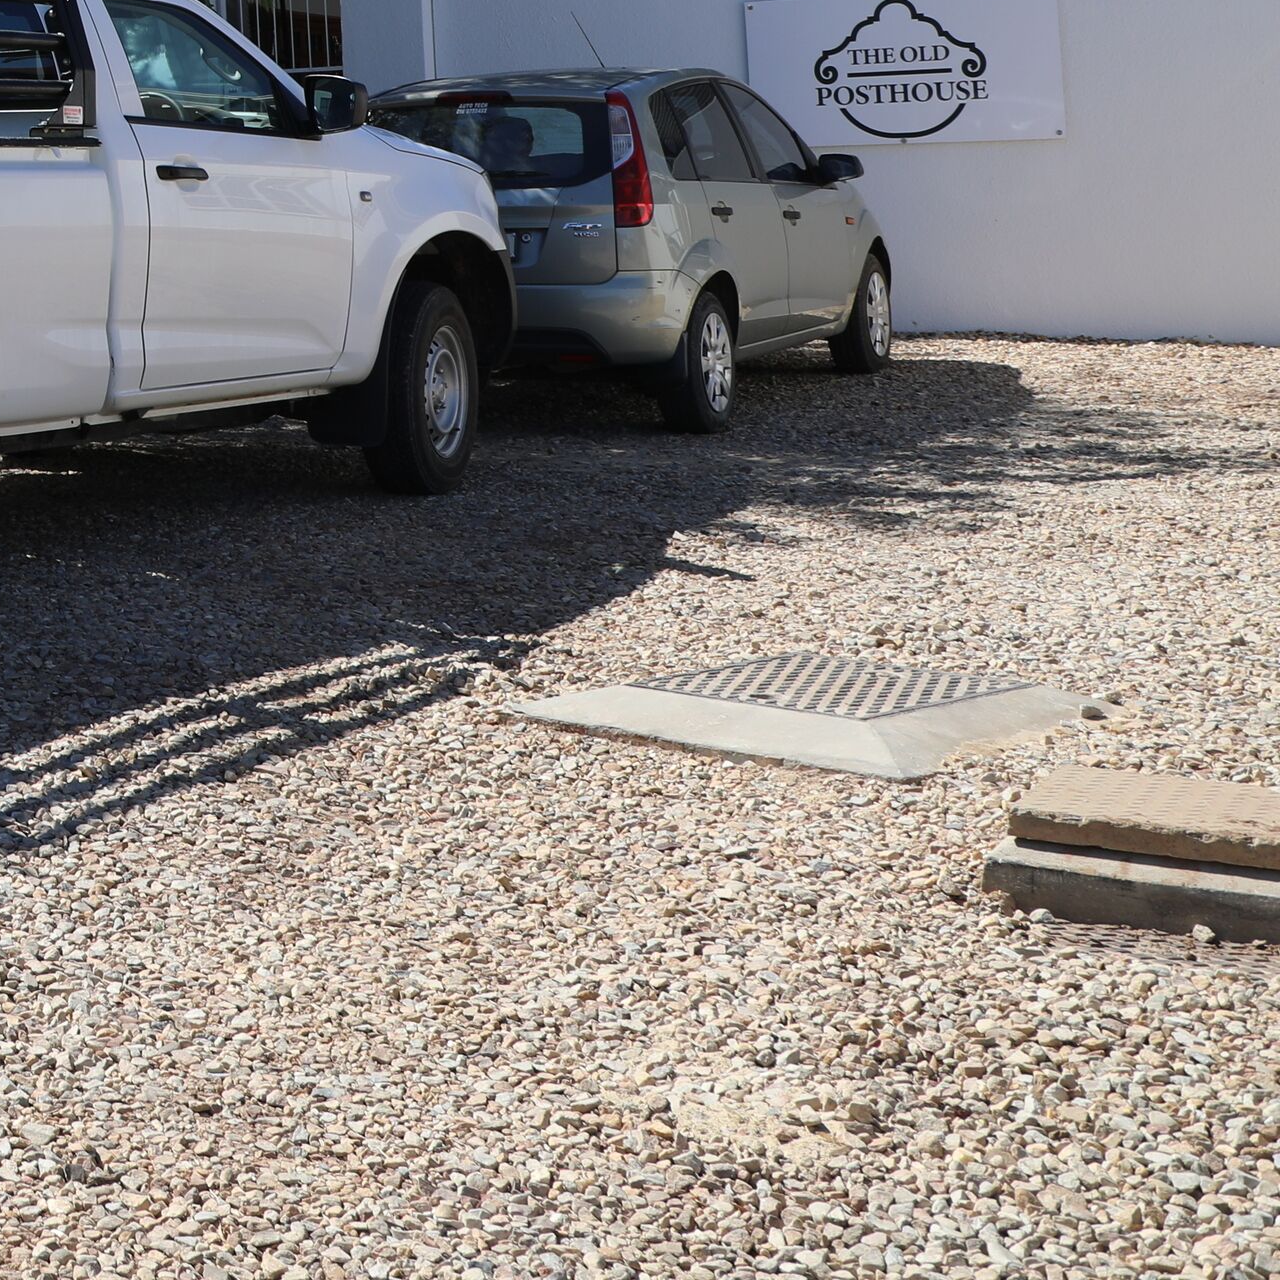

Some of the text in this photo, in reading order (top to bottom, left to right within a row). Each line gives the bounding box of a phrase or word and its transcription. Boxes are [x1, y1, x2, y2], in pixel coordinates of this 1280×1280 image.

[846, 44, 950, 65] THE OLD
[815, 80, 989, 106] POSTHOUSE
